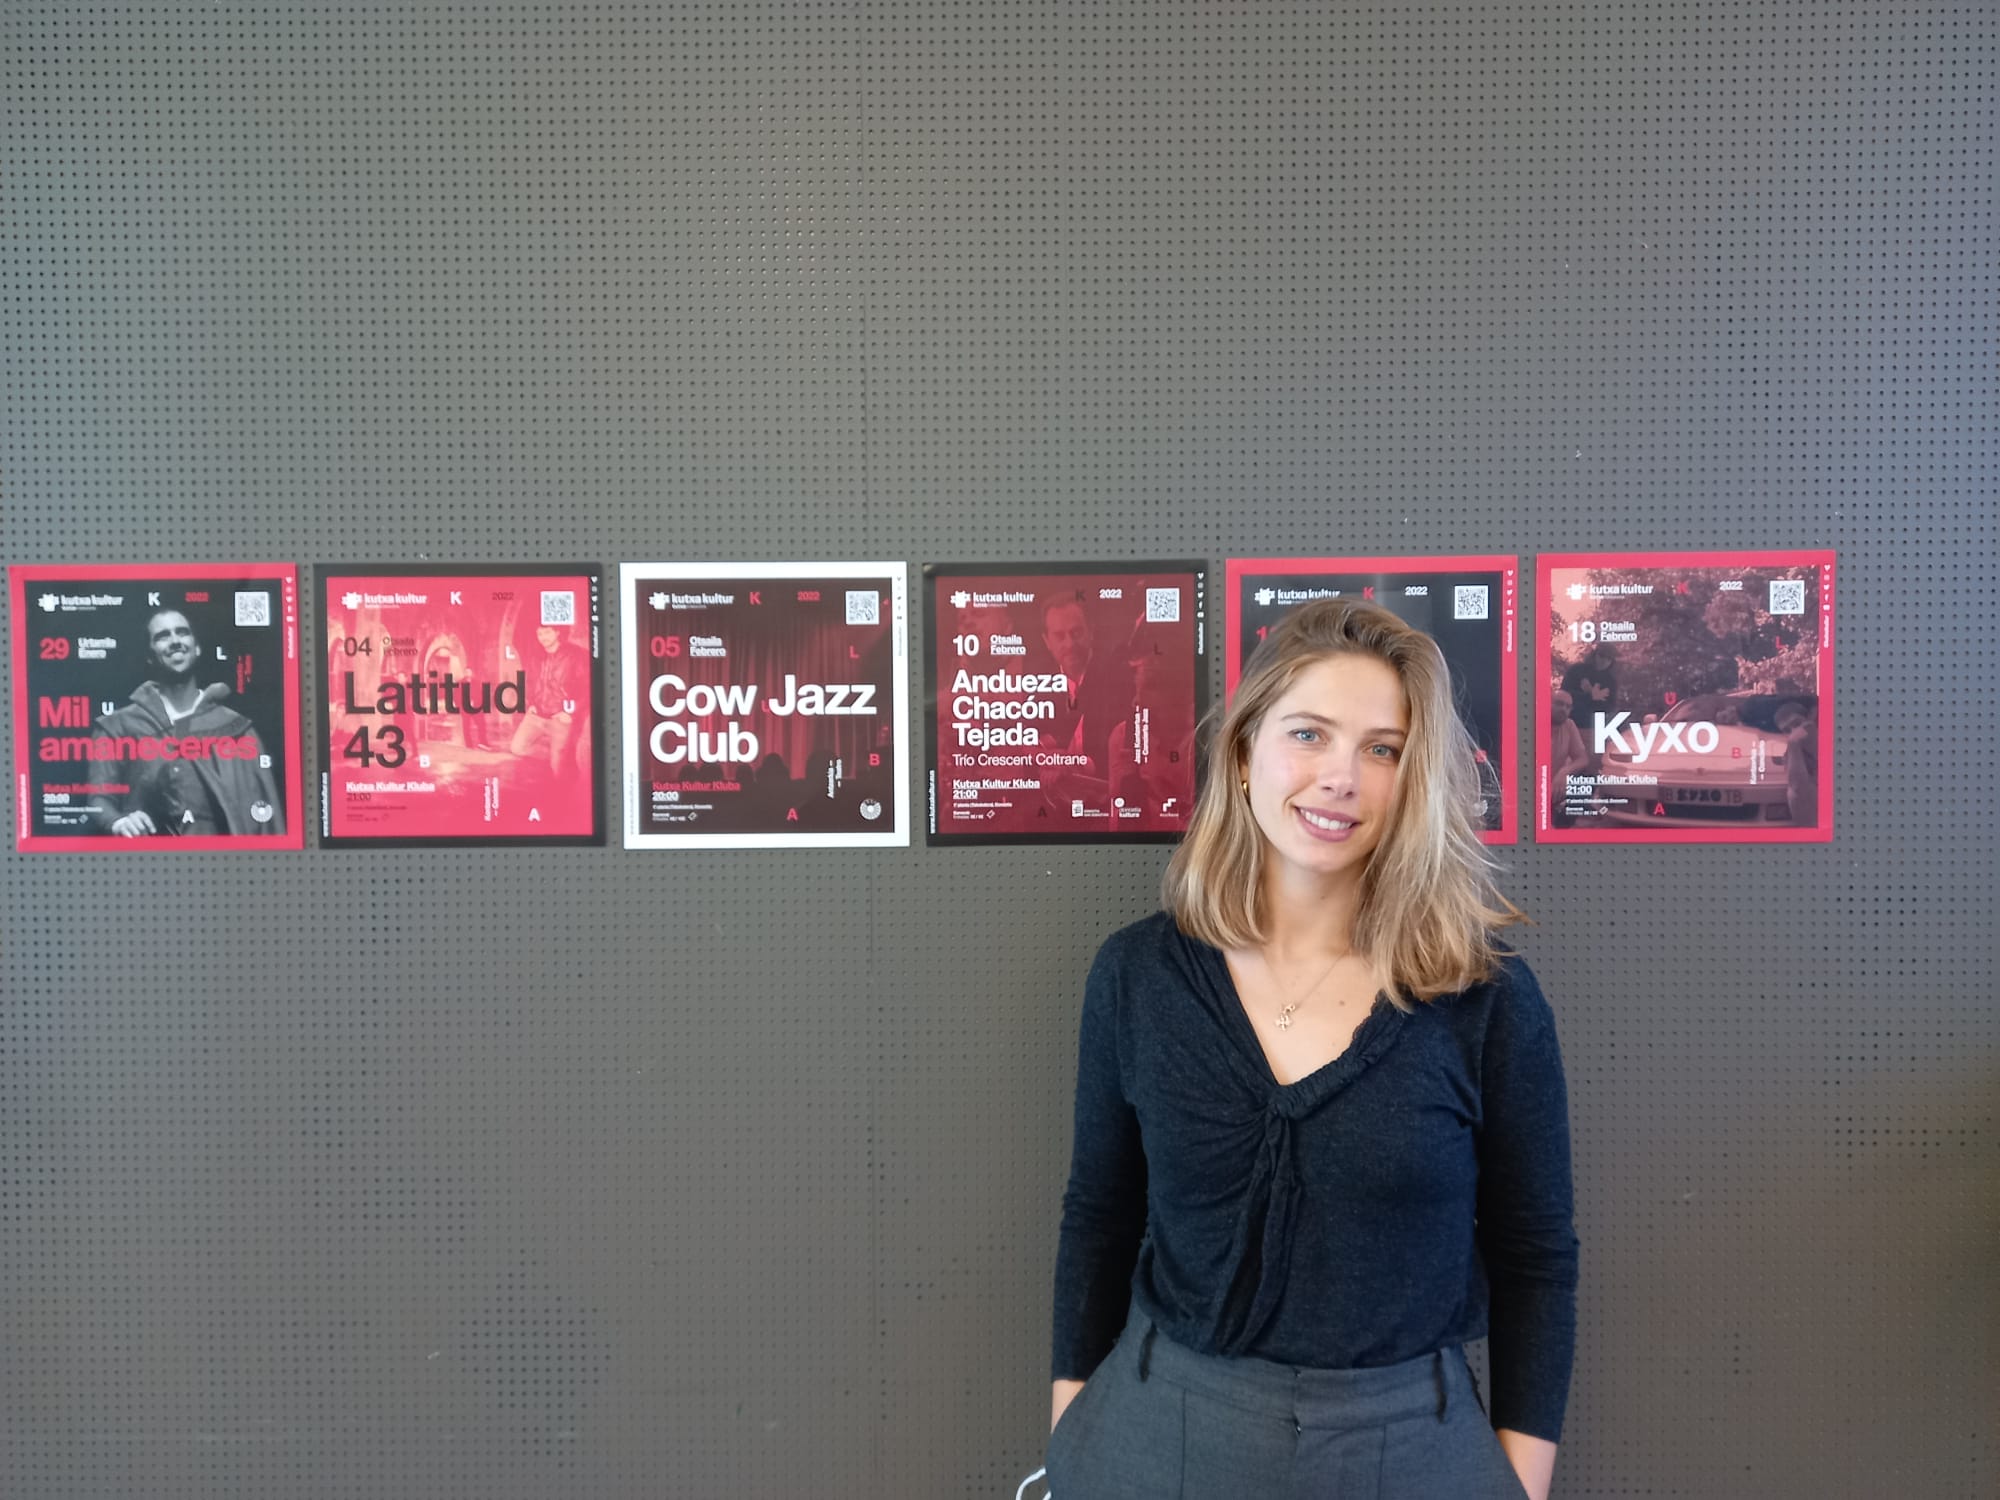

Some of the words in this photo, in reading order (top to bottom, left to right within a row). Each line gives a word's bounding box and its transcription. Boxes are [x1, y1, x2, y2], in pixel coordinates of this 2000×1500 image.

[1362, 586, 1375, 600] K
[1404, 586, 1429, 596] 2022
[1589, 584, 1621, 595] kutxa
[1621, 584, 1654, 594] kultur
[1719, 581, 1743, 591] 2022
[61, 595, 91, 606] kutxa
[91, 594, 123, 606] kultur
[148, 592, 160, 606] K
[364, 593, 395, 604] kutxa
[396, 593, 427, 604] kultur
[450, 591, 463, 605] K
[492, 592, 514, 601] 2022
[671, 593, 702, 605] kutxa
[702, 593, 735, 605] kultur
[749, 591, 762, 605] K
[973, 592, 1003, 603] kutxa
[1003, 592, 1035, 603] kultur
[1099, 589, 1122, 599] 2022
[1277, 589, 1308, 600] kutxa
[1567, 620, 1597, 643] 18
[1600, 621, 1635, 631] Otsaila
[990, 635, 1023, 645] Otsaila
[1600, 632, 1638, 642] Febrero
[40, 637, 70, 660] 29
[344, 636, 372, 657] 04
[505, 645, 516, 660] L
[650, 636, 681, 658] 05
[689, 646, 727, 657] Febrero
[849, 645, 860, 659] L
[952, 635, 980, 656] 10
[990, 646, 1027, 656] Febrero
[216, 646, 227, 660] L
[951, 669, 1069, 693] Andueza
[345, 670, 526, 715] Latitud
[649, 674, 758, 717] Cow
[768, 674, 878, 717] Jazz
[1664, 691, 1677, 705] U
[39, 696, 91, 728] Mil
[101, 701, 114, 716] U
[562, 699, 575, 714] U
[952, 695, 1055, 720] Chacón
[649, 721, 760, 764] Club
[952, 722, 1040, 752] Tejada
[1594, 711, 1720, 764] Kyxo
[39, 736, 258, 762] amaneceres
[343, 725, 407, 769] 43
[1731, 746, 1742, 759] B
[259, 755, 272, 769] B
[869, 753, 880, 766] B
[977, 753, 1033, 767] Crescent
[1035, 753, 1088, 767] Coltrane
[952, 779, 981, 790] Kutxa
[982, 779, 1011, 790] Kultur
[1012, 779, 1041, 790] Kluba
[1566, 774, 1596, 785] Kutxa
[1597, 774, 1626, 785] Kultur
[1628, 774, 1658, 785] Kluba
[652, 791, 680, 802] 20:00
[952, 790, 978, 800] 21:00
[1566, 785, 1592, 795] 21:00
[528, 807, 541, 822] A
[786, 807, 799, 822] A
[1653, 801, 1666, 815] A
[182, 810, 195, 824] A
